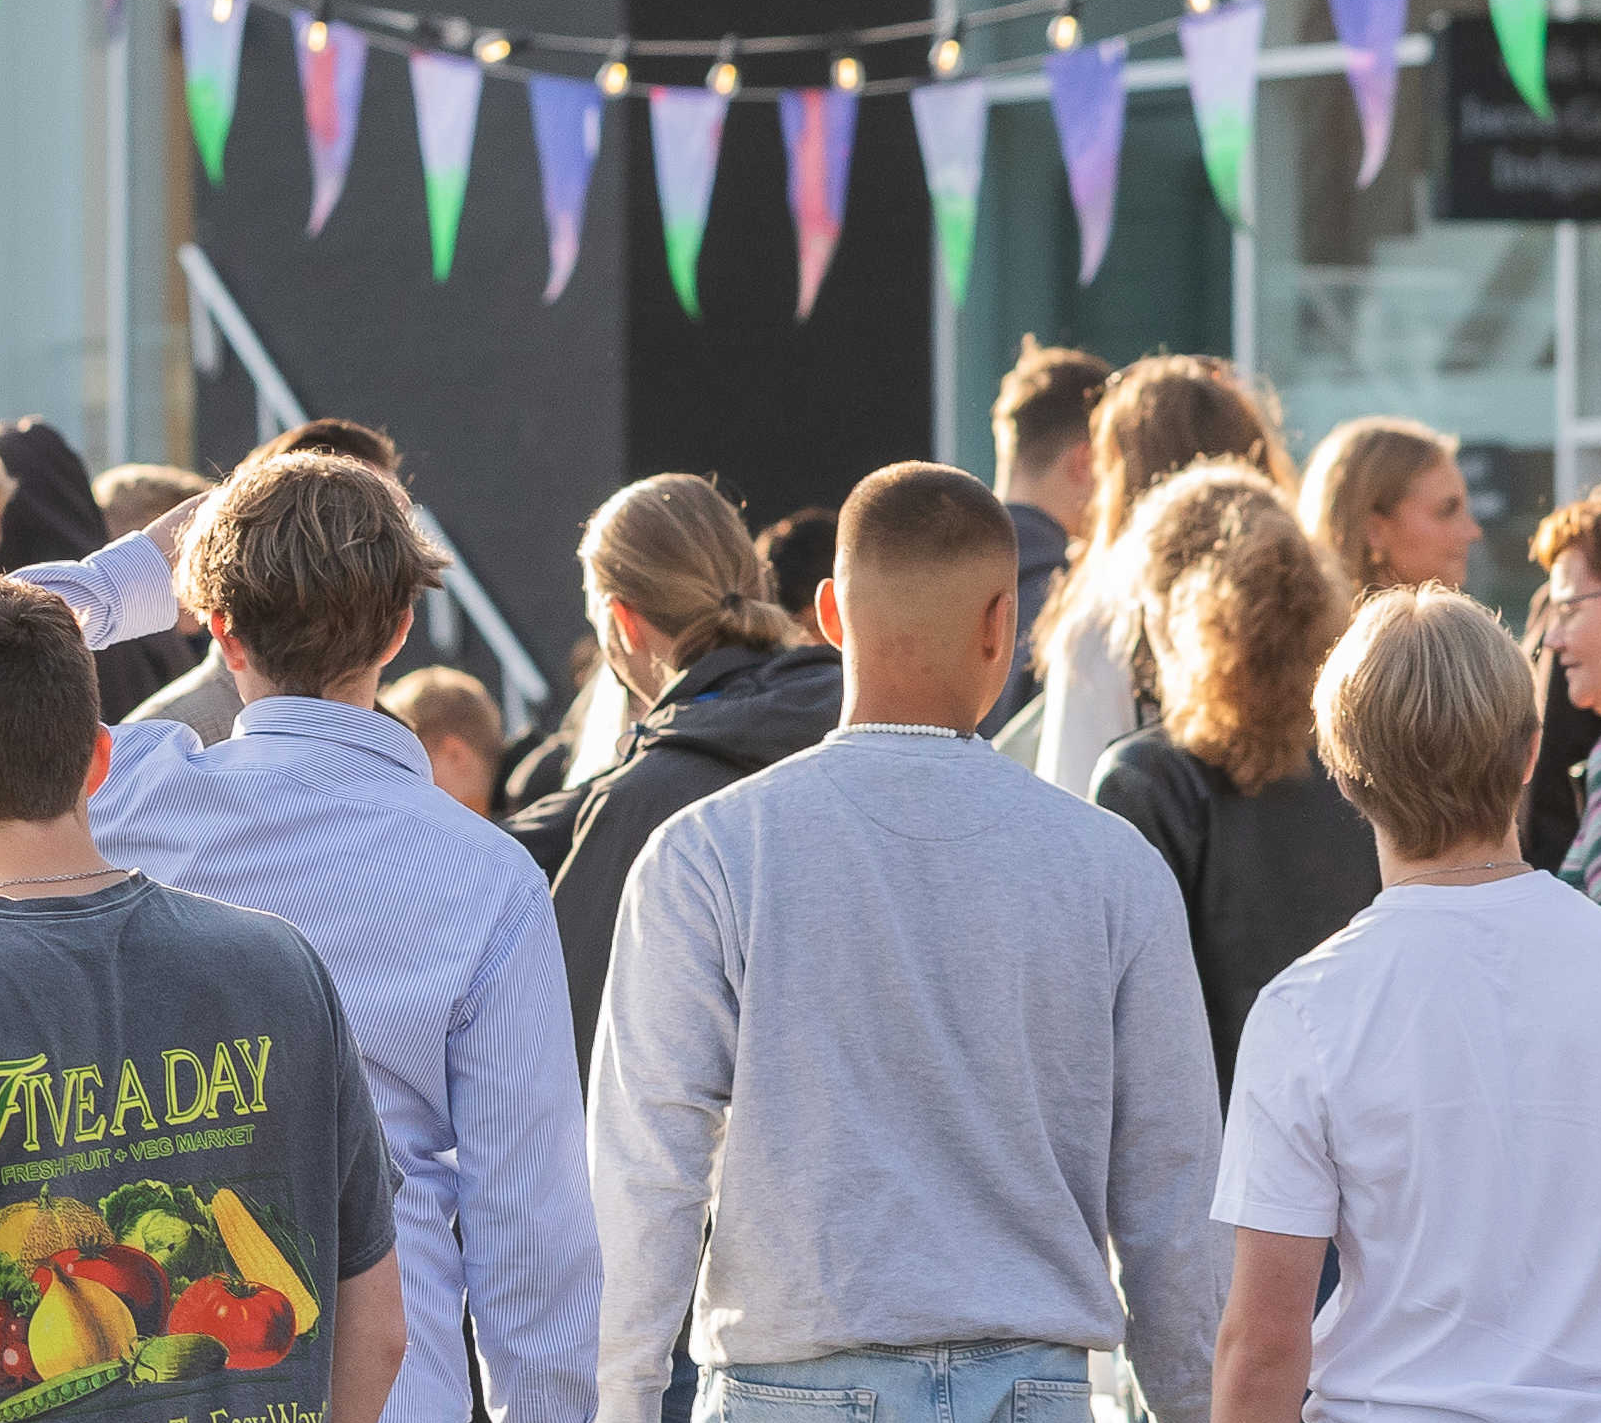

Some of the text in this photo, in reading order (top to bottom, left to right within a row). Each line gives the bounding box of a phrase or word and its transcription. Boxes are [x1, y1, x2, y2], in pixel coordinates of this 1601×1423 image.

[110, 1058, 159, 1137] A
[161, 1035, 272, 1126] DAY
[1, 1157, 65, 1186] FRESH
[65, 1147, 112, 1175] FRUIT
[129, 1137, 174, 1162] VEG
[175, 1124, 256, 1154] MARKET
